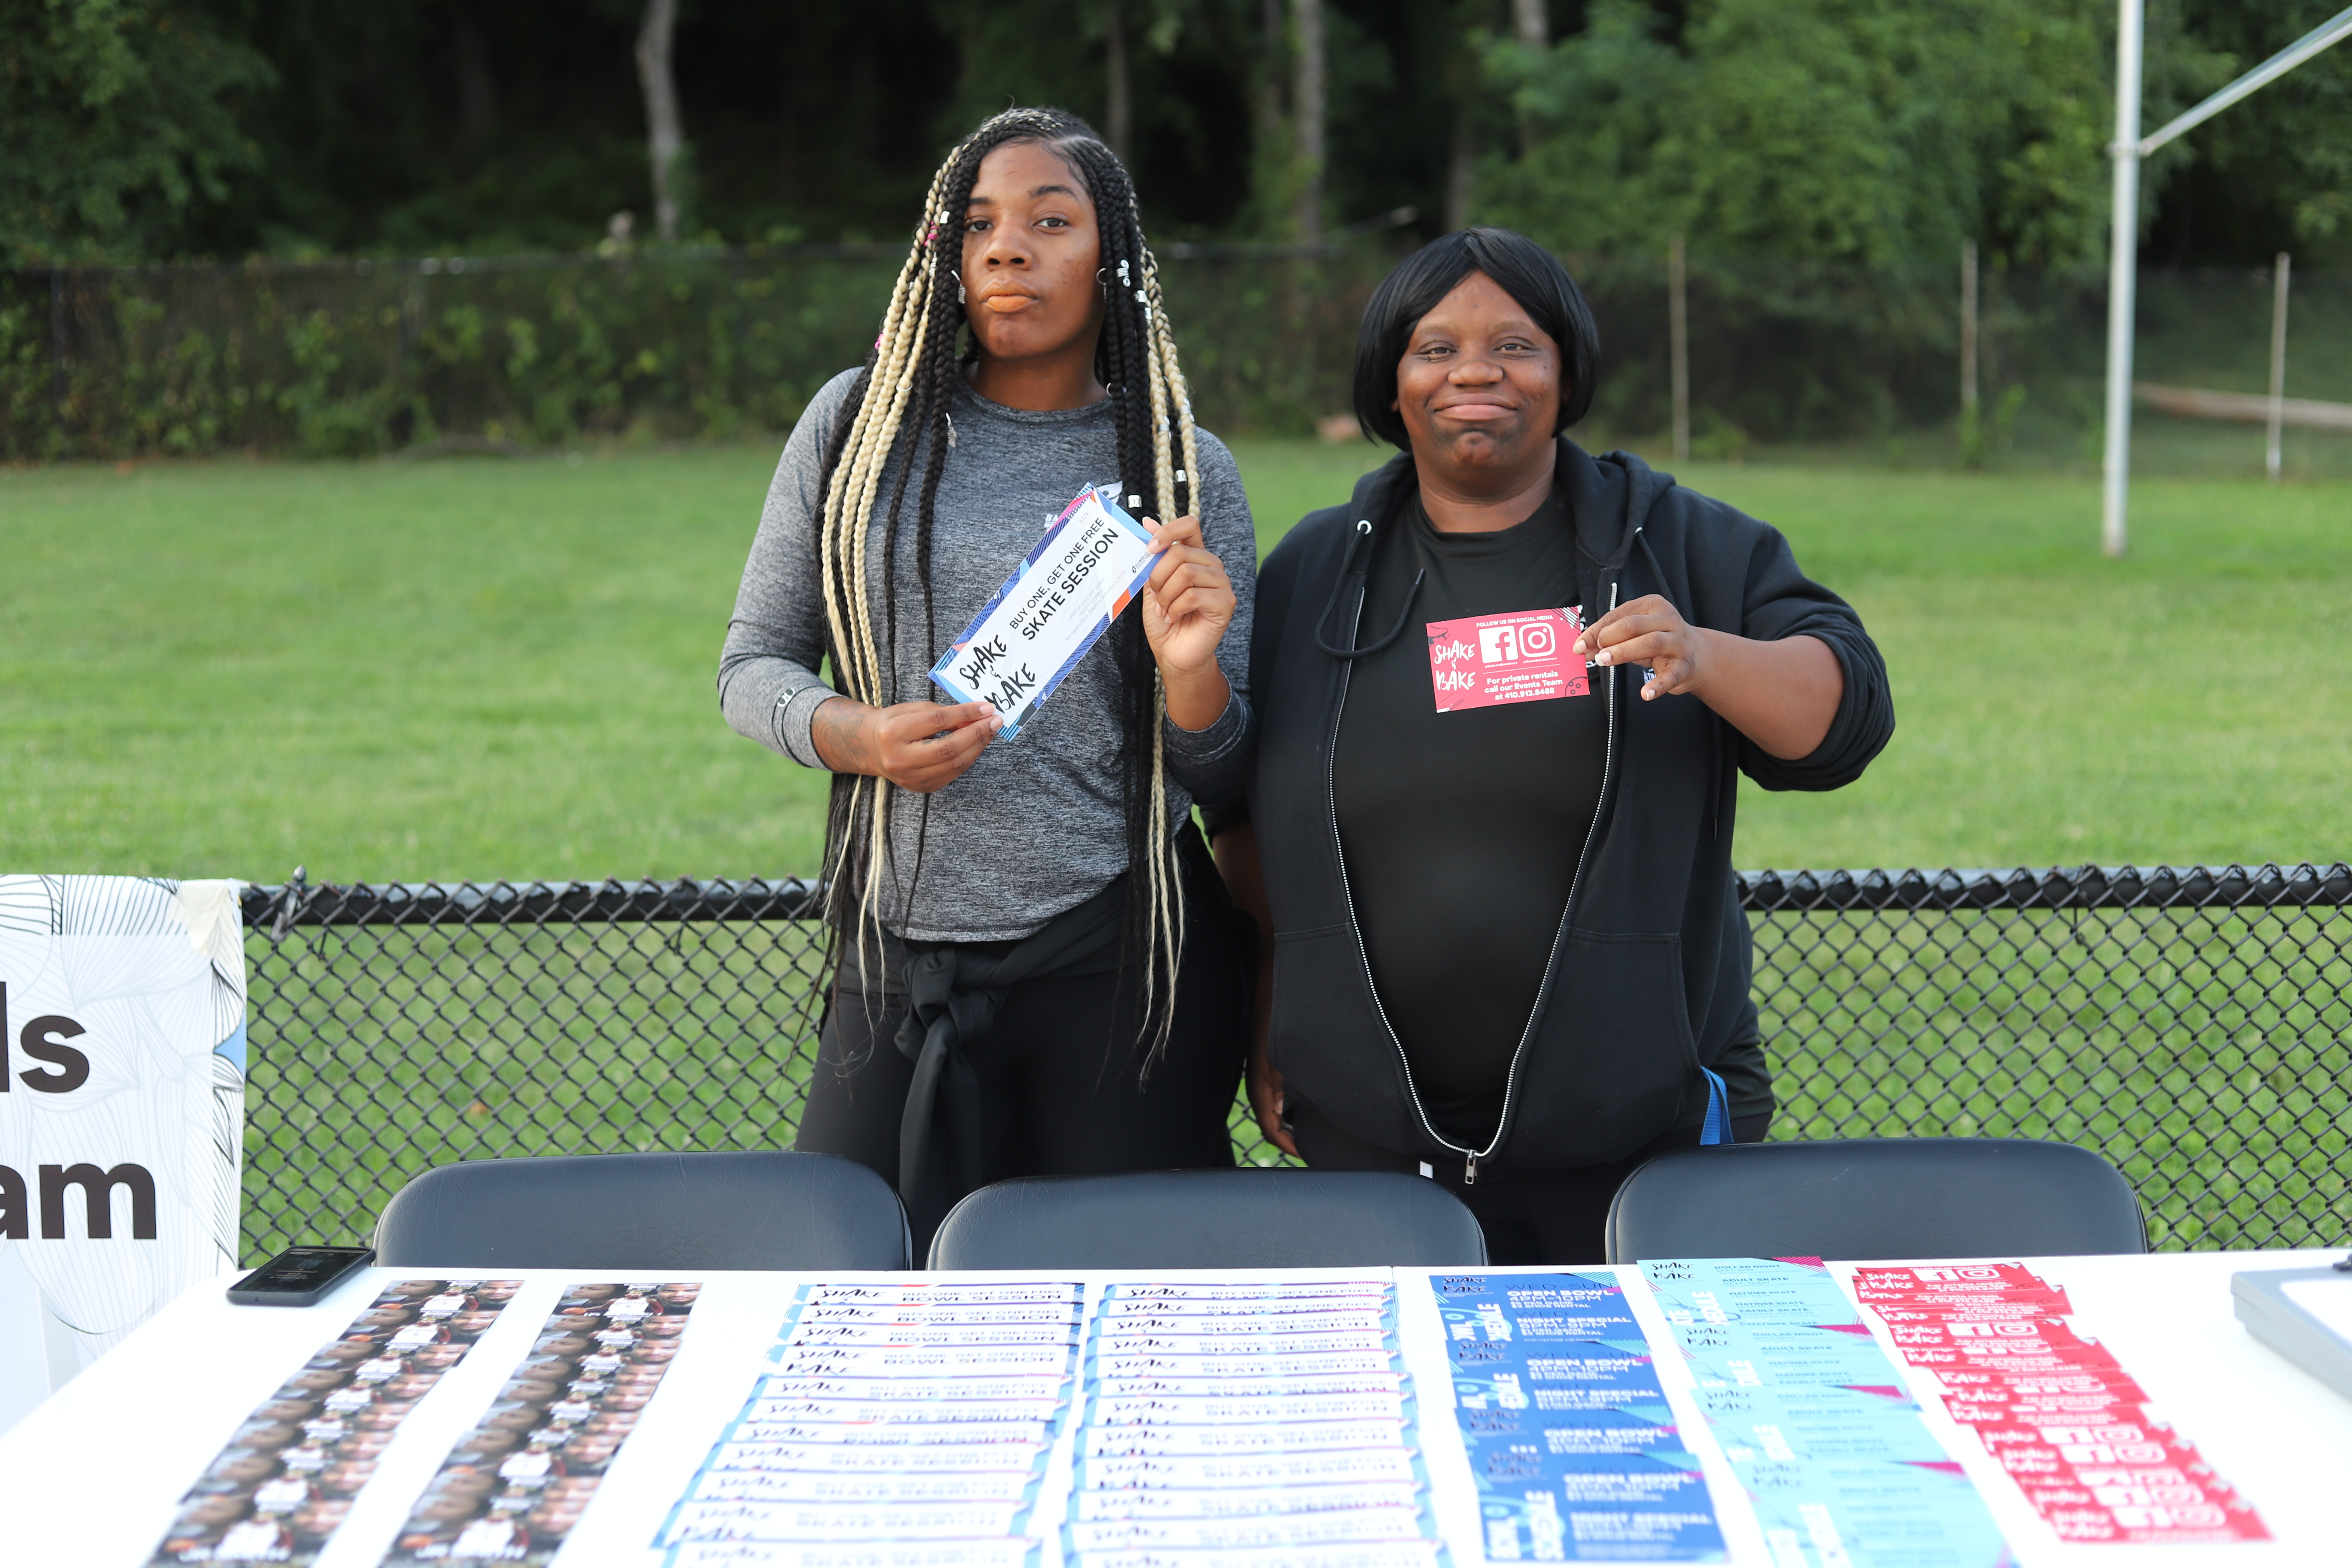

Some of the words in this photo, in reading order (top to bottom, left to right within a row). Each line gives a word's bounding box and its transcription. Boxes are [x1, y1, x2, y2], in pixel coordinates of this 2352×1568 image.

[1079, 512, 1089, 524] 0329
[1009, 608, 1028, 629] BUY
[1027, 586, 1050, 608] ONE,
[1047, 564, 1065, 584] GET
[1064, 542, 1084, 564] ONE
[1081, 518, 1104, 544] FREE
[1022, 591, 1066, 640] SKATE
[1061, 528, 1119, 594] SESSION
[1070, 624, 1081, 635] cash
[1088, 599, 1102, 615] Expires
[1100, 583, 1115, 601] January
[1079, 605, 1088, 616] Void
[1067, 610, 1078, 621] Limit
[1434, 640, 1475, 664] SHAKE
[960, 634, 1006, 689] SHAKE
[1436, 670, 1476, 691] BAKE
[1502, 674, 1530, 684] private
[1531, 670, 1559, 680] rentals
[984, 662, 1035, 714] BAKE
[1484, 685, 1499, 693] call
[1514, 681, 1540, 690] Events
[1504, 687, 1555, 699] 410.913.8488
[1651, 1262, 1694, 1271] SHAKE
[1442, 1276, 1487, 1284] SHAKE
[1870, 1281, 1914, 1289] BAKE
[817, 1288, 887, 1298] SHAKE
[1126, 1288, 1194, 1298] SHAKE
[1119, 1302, 1189, 1312] SHAKE
[812, 1308, 881, 1318] SHAKE
[1113, 1319, 1182, 1330] SHAKE
[1276, 1322, 1369, 1330] SESSION
[806, 1327, 875, 1338] SHAKE
[1109, 1339, 1181, 1350] SHAKE
[798, 1349, 868, 1360] SHAKE
